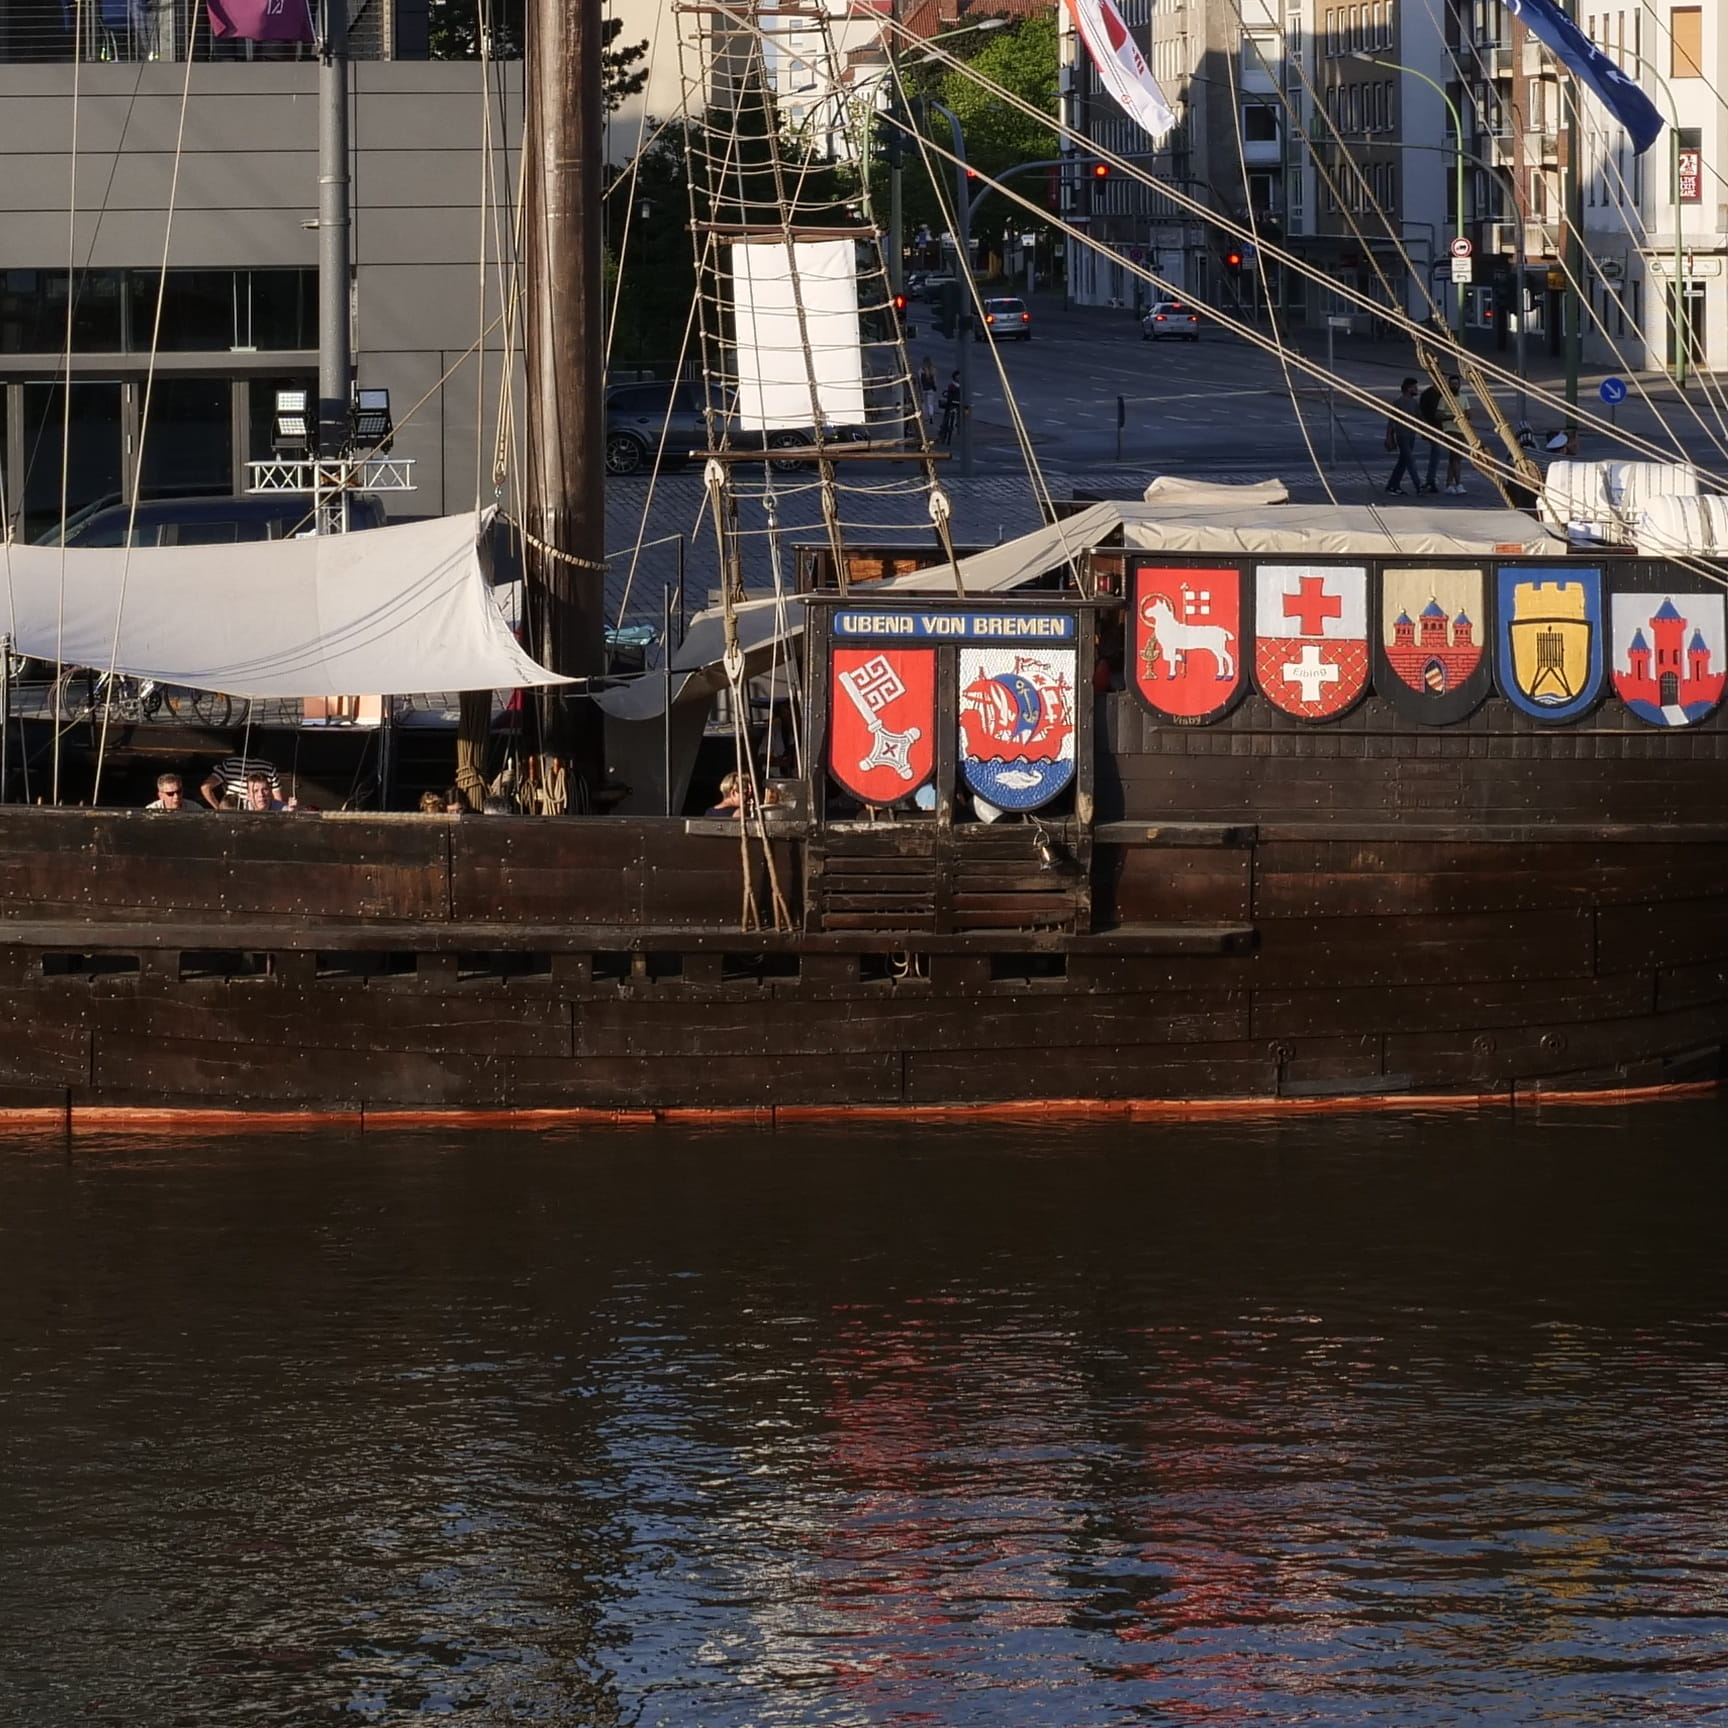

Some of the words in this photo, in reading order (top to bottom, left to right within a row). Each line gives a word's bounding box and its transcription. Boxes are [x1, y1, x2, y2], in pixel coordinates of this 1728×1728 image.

[843, 616, 914, 633] UBENA
[922, 617, 965, 634] VON
[973, 618, 1065, 635] BREMEN
